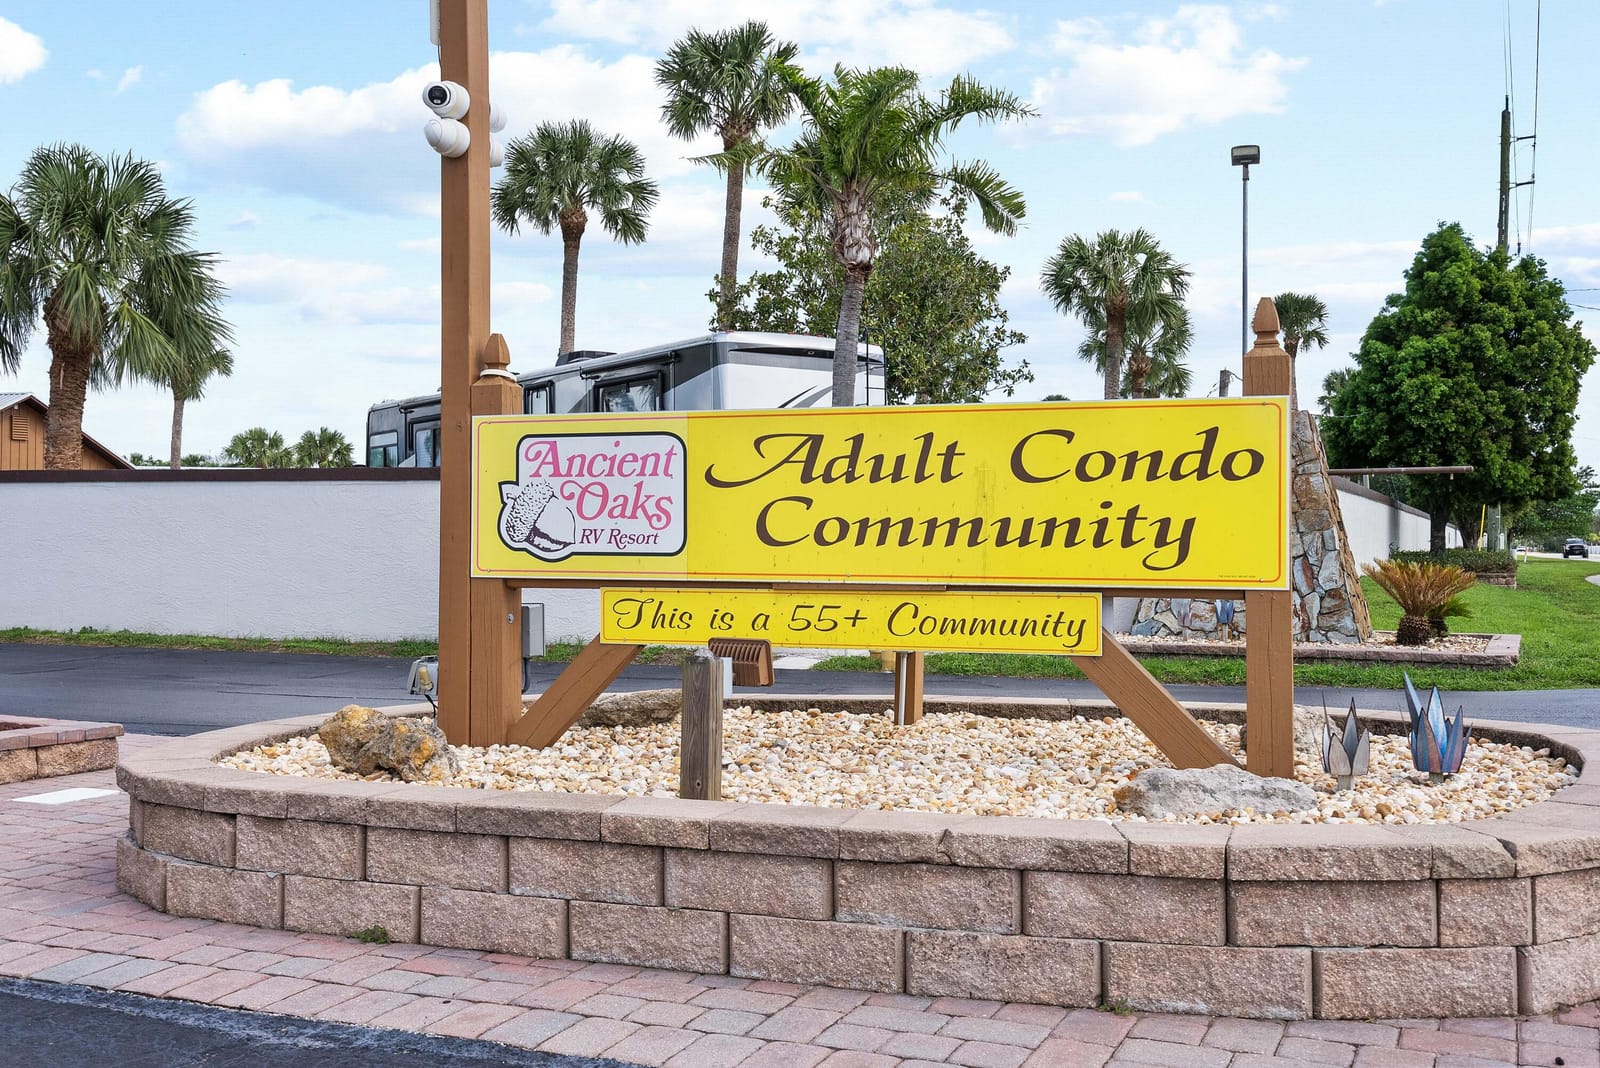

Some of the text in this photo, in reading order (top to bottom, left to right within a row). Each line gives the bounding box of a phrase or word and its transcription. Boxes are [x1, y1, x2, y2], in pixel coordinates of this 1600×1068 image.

[524, 440, 678, 478] Ancient
[704, 426, 1265, 489] Adult Condo
[560, 480, 674, 531] Oaks
[579, 528, 660, 550] RV Resort
[756, 496, 1197, 571] Community
[612, 597, 1087, 648] This is a 55+ Community
